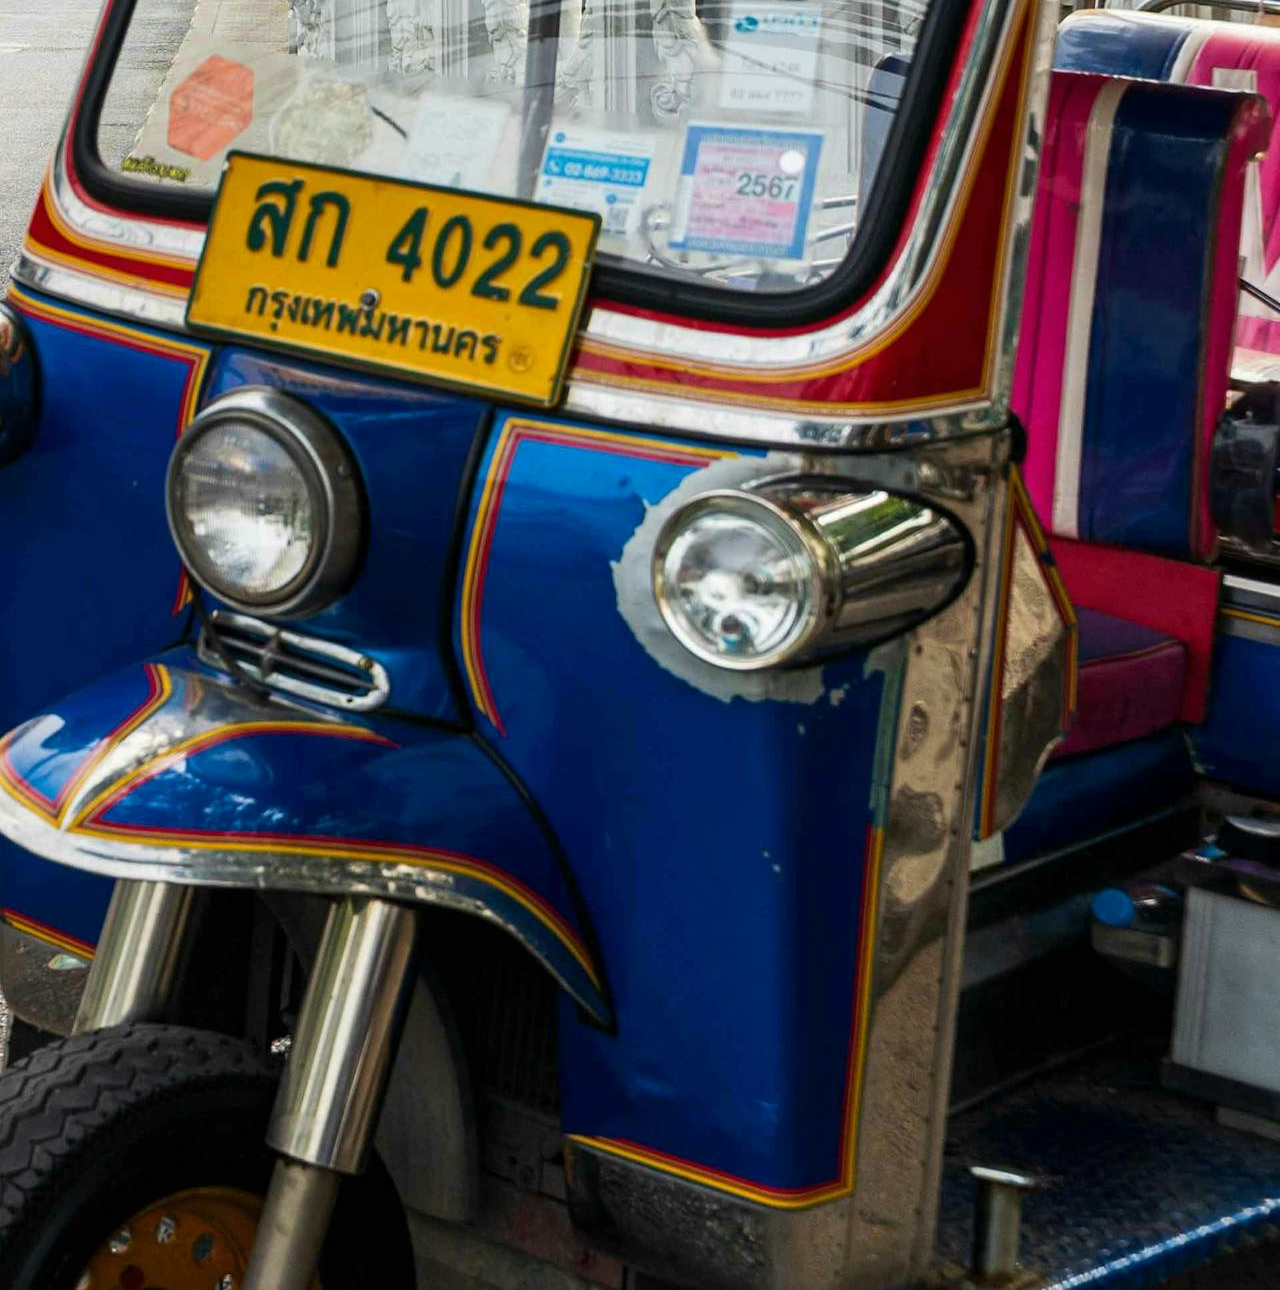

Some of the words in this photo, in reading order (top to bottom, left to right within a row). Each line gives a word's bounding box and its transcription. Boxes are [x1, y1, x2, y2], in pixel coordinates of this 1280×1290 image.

[736, 173, 799, 201] 2567
[246, 179, 351, 269] สก
[386, 207, 571, 311] 4022
[244, 285, 504, 365] กรุงเทพมหานคร
